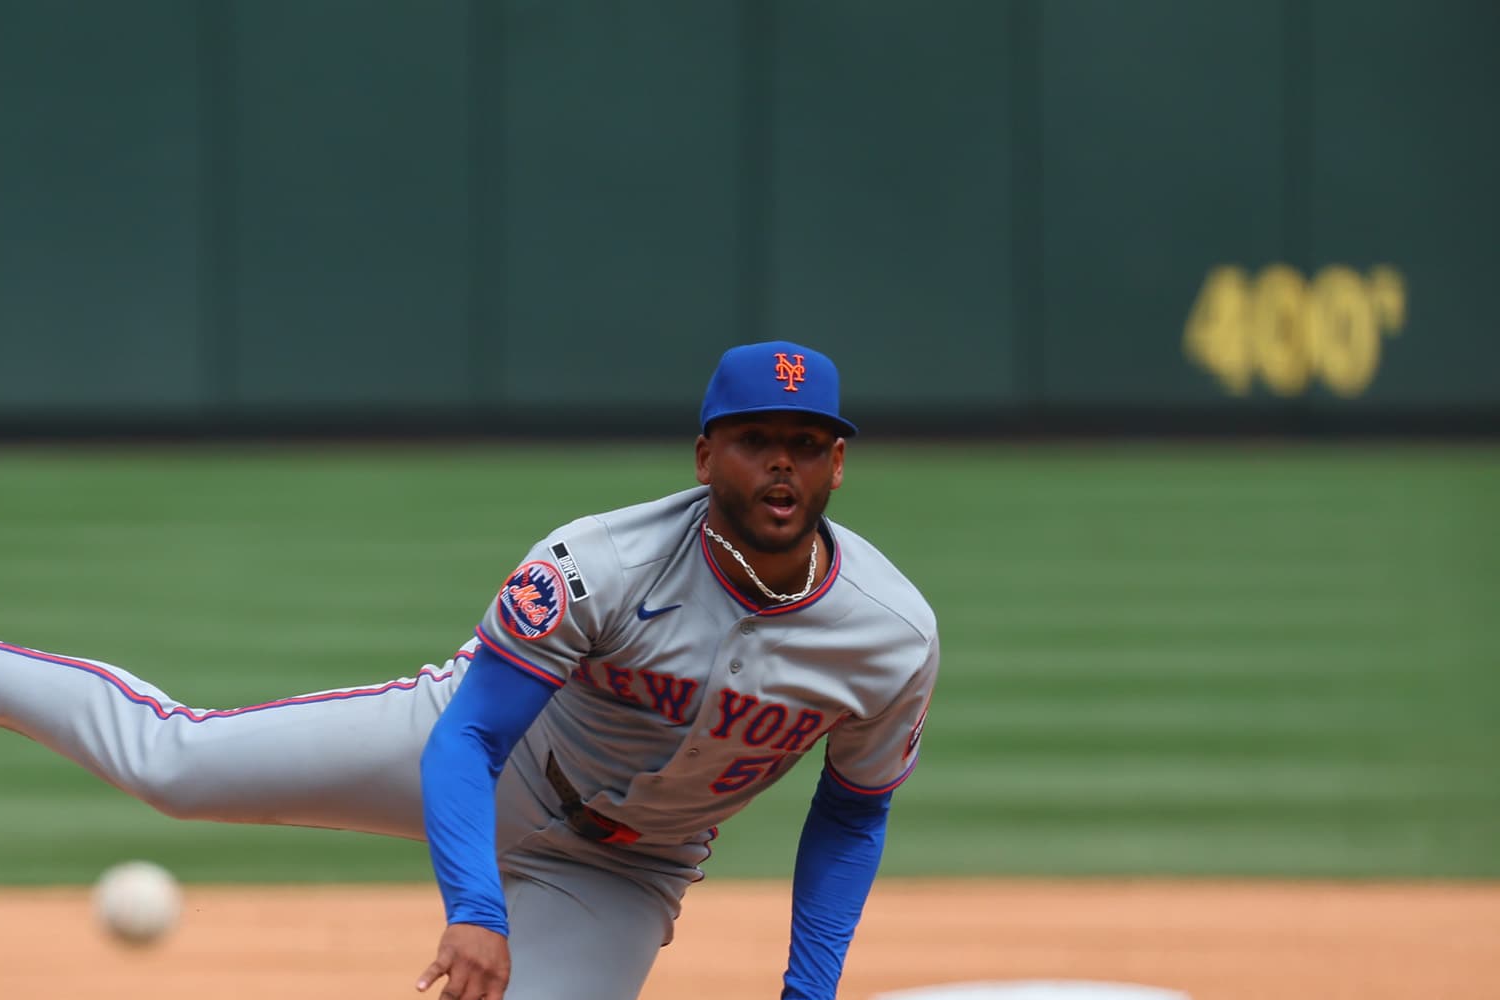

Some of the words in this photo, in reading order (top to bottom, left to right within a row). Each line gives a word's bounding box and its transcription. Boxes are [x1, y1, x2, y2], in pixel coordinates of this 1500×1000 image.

[558, 554, 580, 581] DAVEY
[508, 583, 548, 625] Mets
[709, 688, 845, 752] YOR
